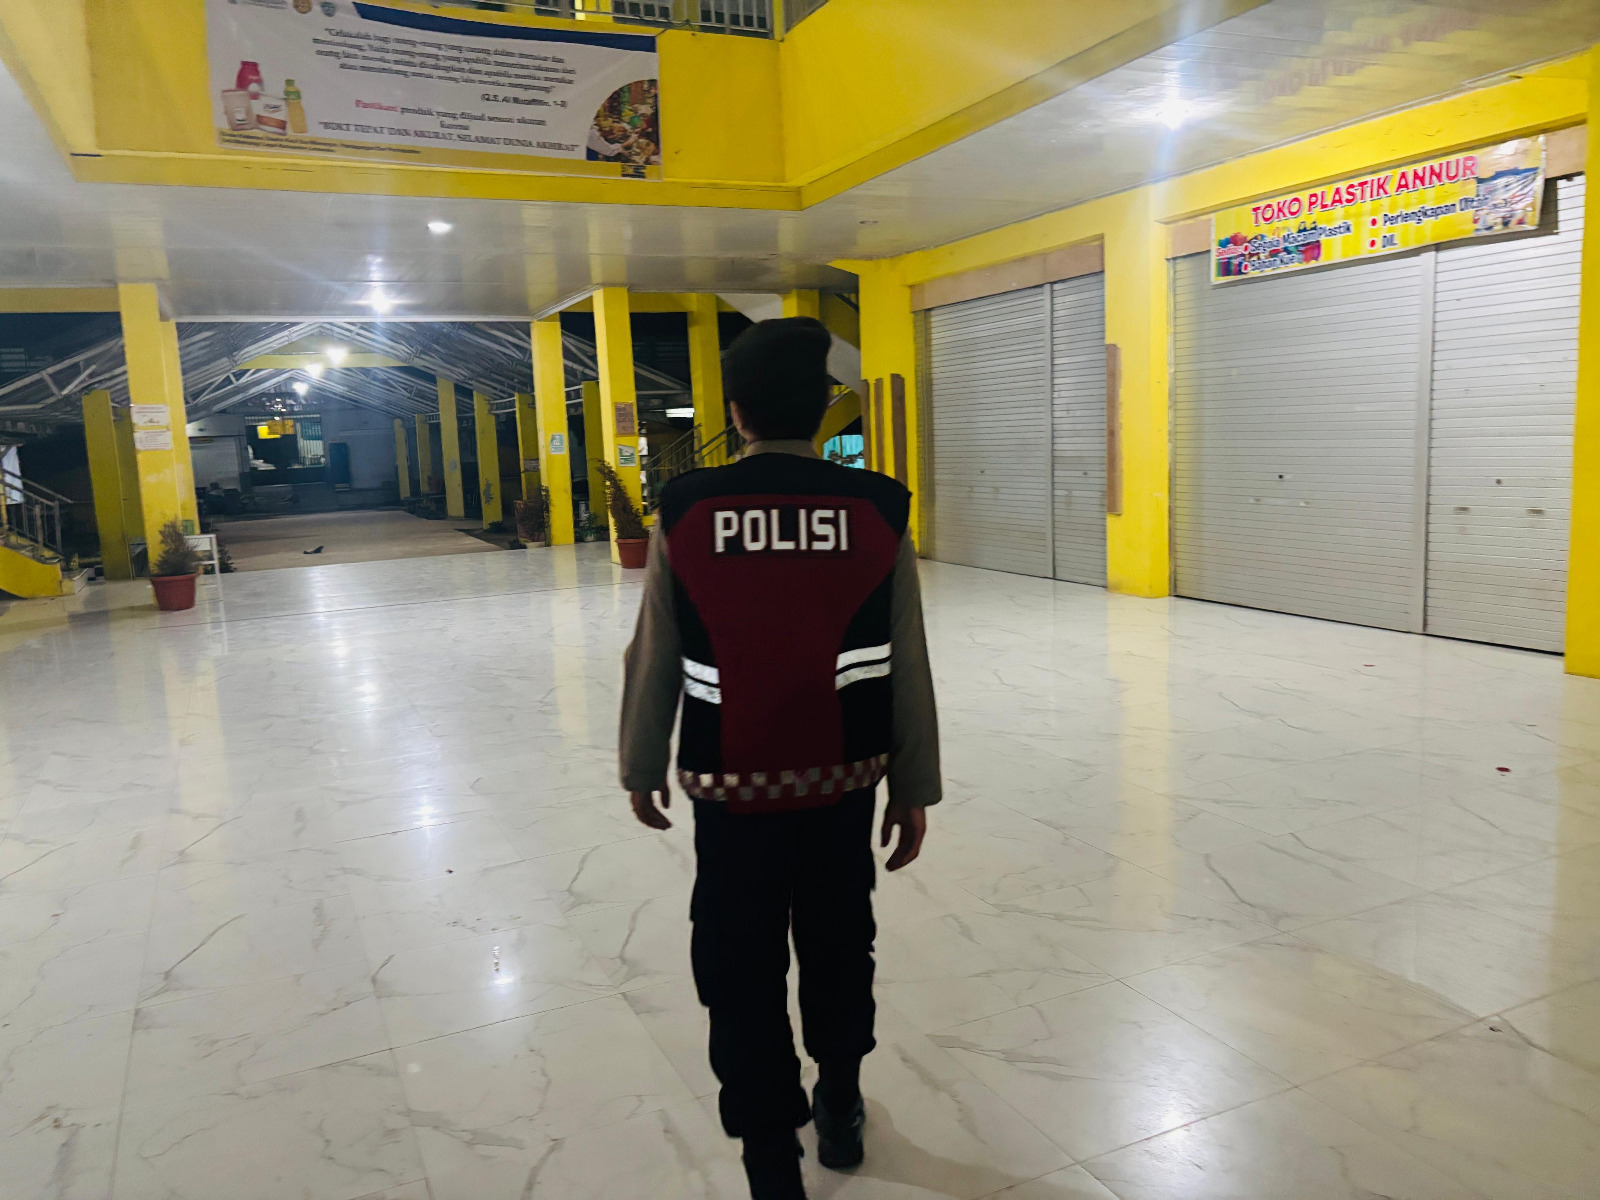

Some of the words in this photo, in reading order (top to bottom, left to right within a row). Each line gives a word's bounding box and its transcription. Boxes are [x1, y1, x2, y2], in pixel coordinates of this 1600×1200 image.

[1251, 197, 1302, 226] TOKO
[1308, 174, 1393, 215] PLASTIK
[1396, 155, 1478, 195] ANNUR
[1382, 203, 1457, 226] Perlengkapan
[714, 508, 849, 553] POLISI
